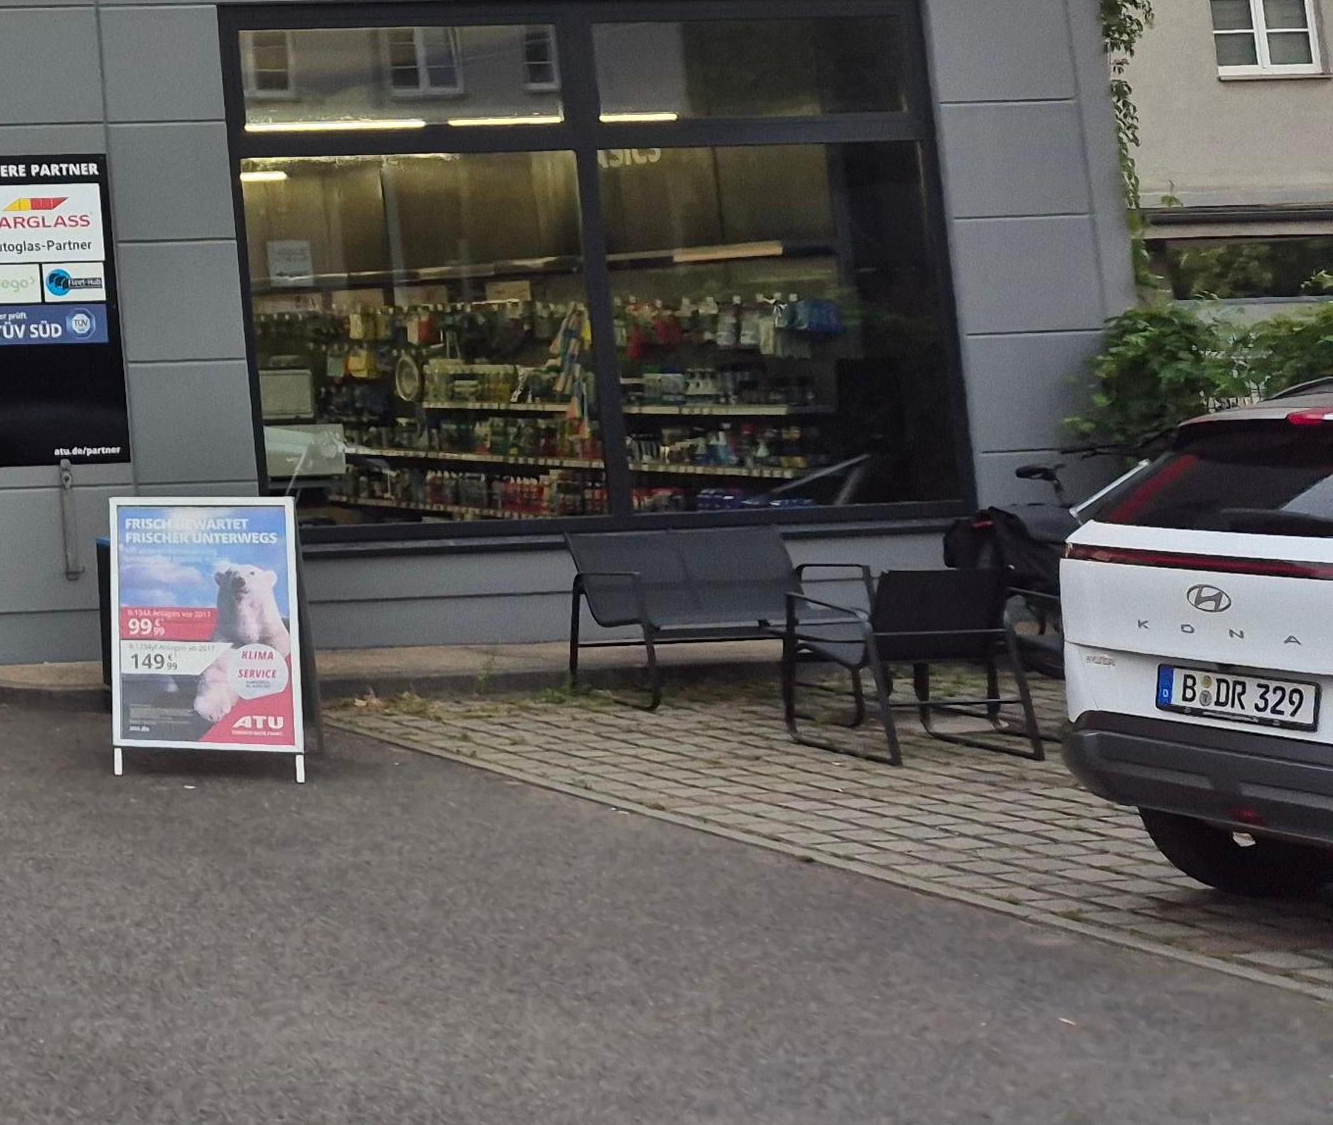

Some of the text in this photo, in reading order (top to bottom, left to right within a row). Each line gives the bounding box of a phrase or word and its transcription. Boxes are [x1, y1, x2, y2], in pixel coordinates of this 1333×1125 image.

[30, 162, 100, 176] PARTNER
[29, 320, 63, 338] SÜD
[54, 446, 121, 457] atu.de/partner
[125, 532, 278, 544] FRISCHER UNTERWEGS
[128, 618, 152, 635] 99
[153, 627, 165, 636] 99
[1137, 619, 1302, 646] KONA
[130, 653, 165, 670] 149
[166, 662, 178, 671] 99
[241, 650, 274, 661] KLIMA
[237, 668, 277, 679] SERVICE
[1181, 674, 1304, 718] B DR 329
[233, 715, 285, 730] ATU
